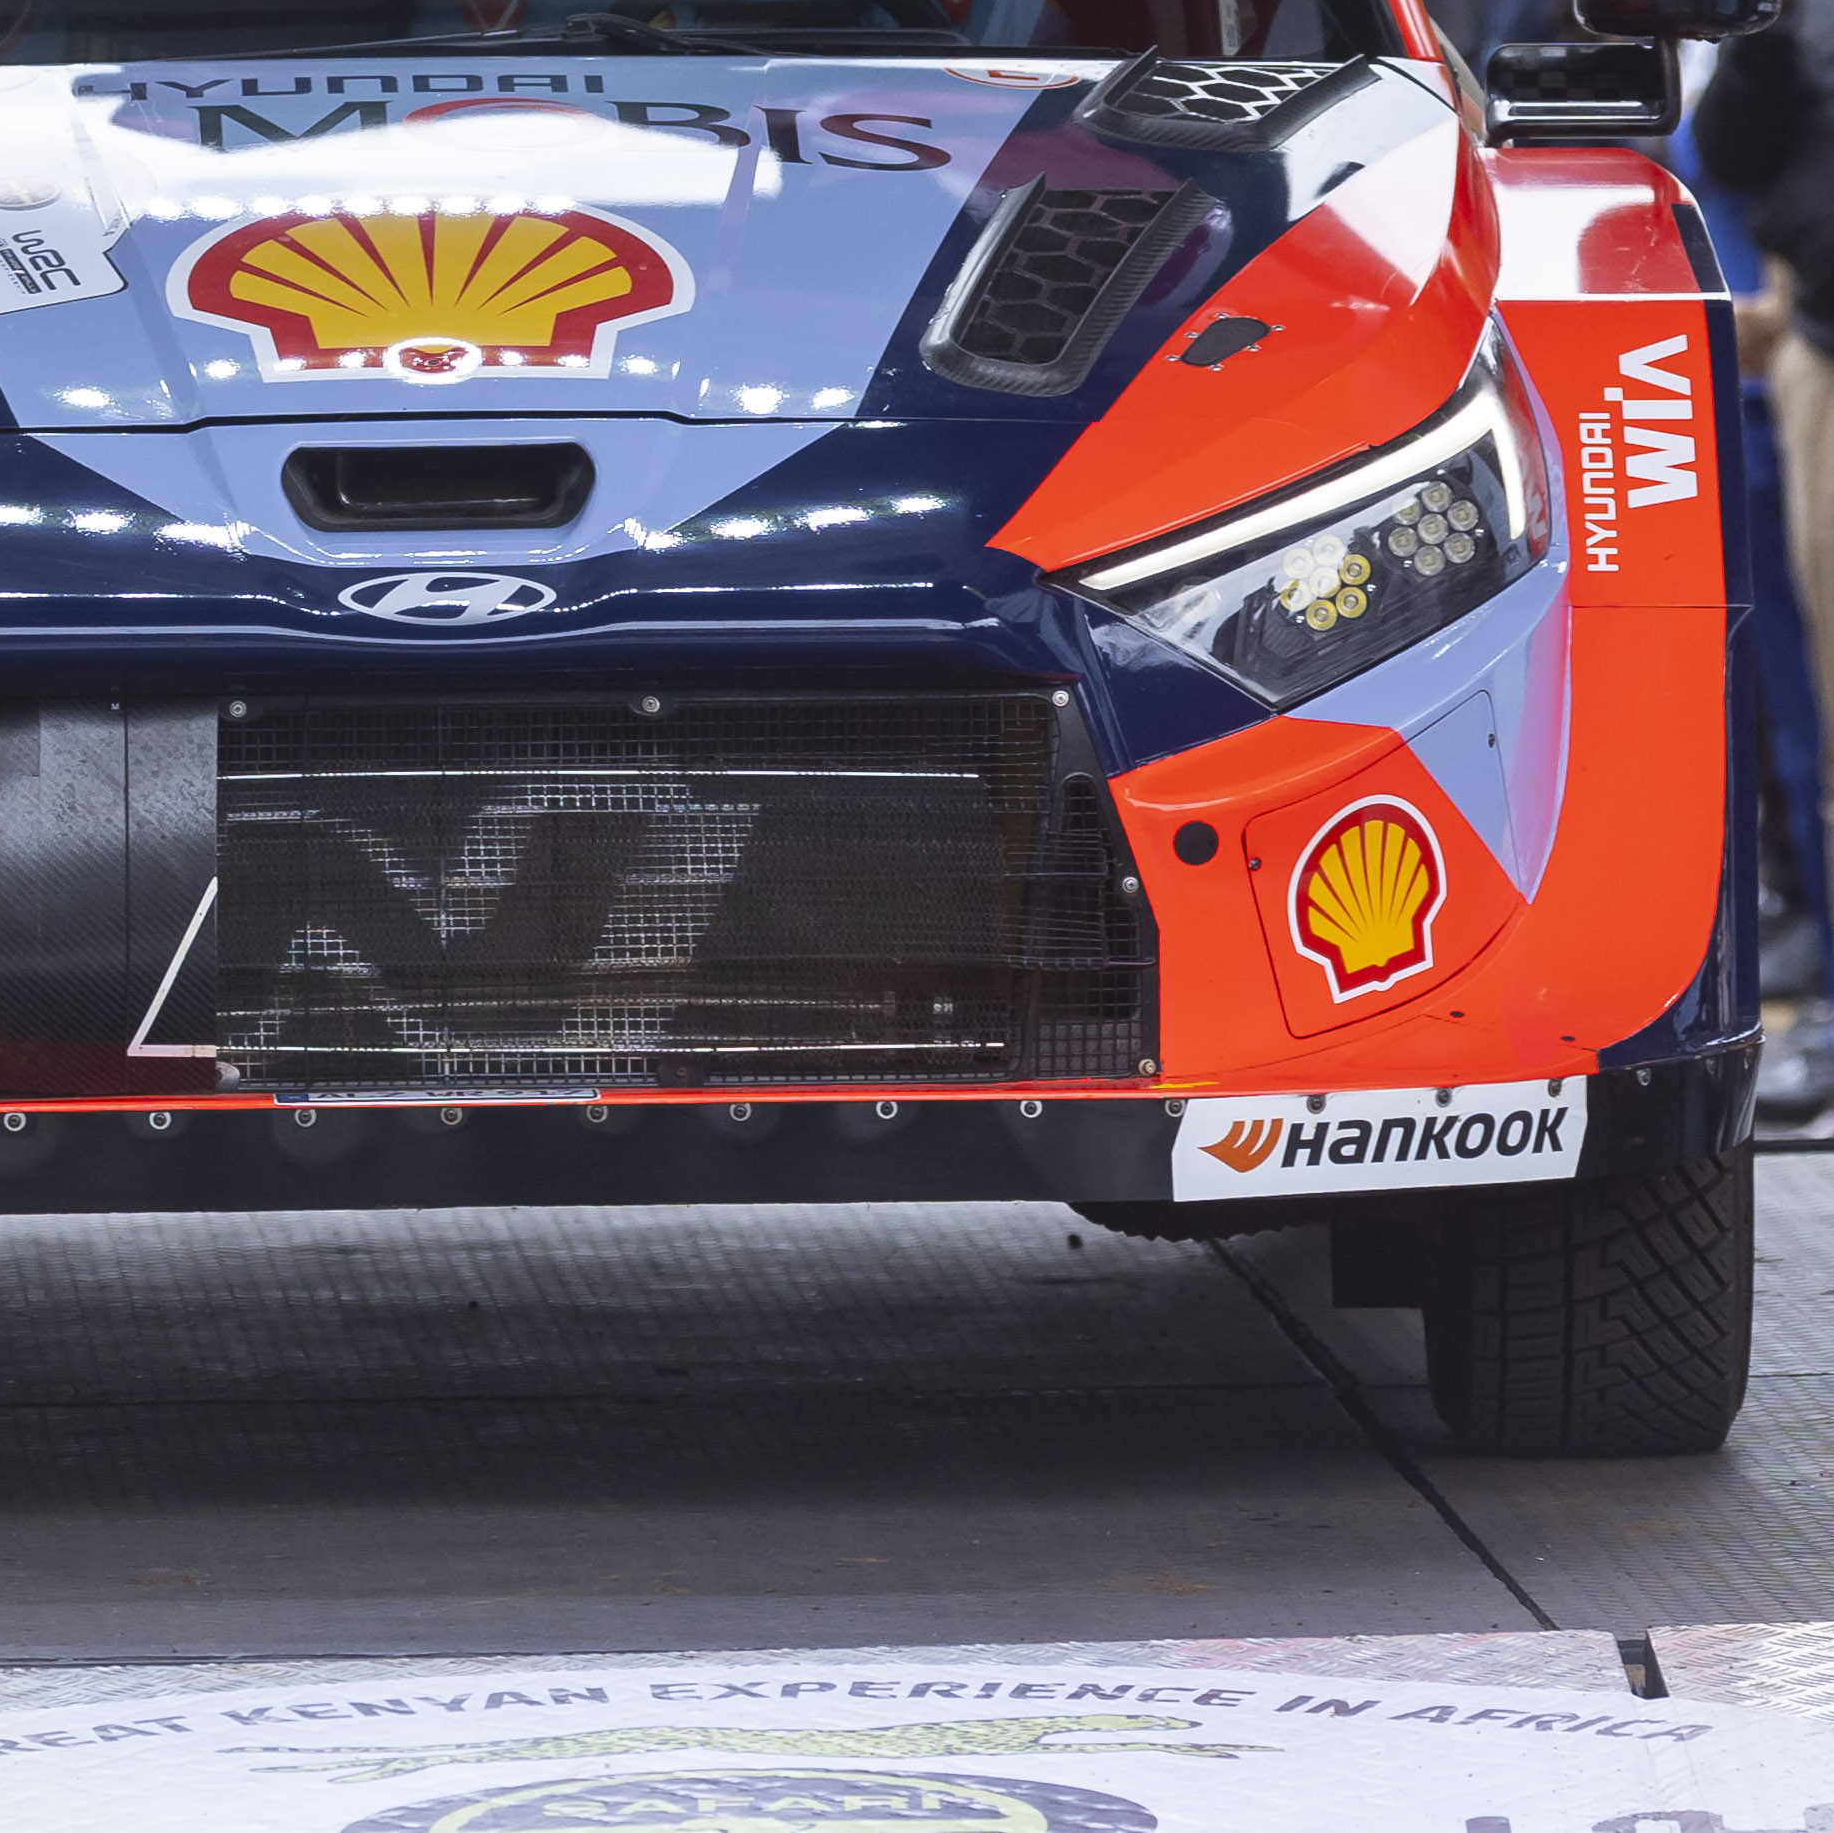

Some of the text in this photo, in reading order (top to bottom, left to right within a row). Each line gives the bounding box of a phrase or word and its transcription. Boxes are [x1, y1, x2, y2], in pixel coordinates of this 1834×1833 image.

[11, 229, 82, 291] WRC
[1578, 410, 1622, 573] HYUNDAI
[220, 1685, 612, 1727] KENYAN
[648, 1680, 1262, 1710] EXPERIENCE
[1273, 1693, 1382, 1719] IN
[1388, 1703, 1716, 1744] AFRICA
[539, 1793, 943, 1819] SAFARI
